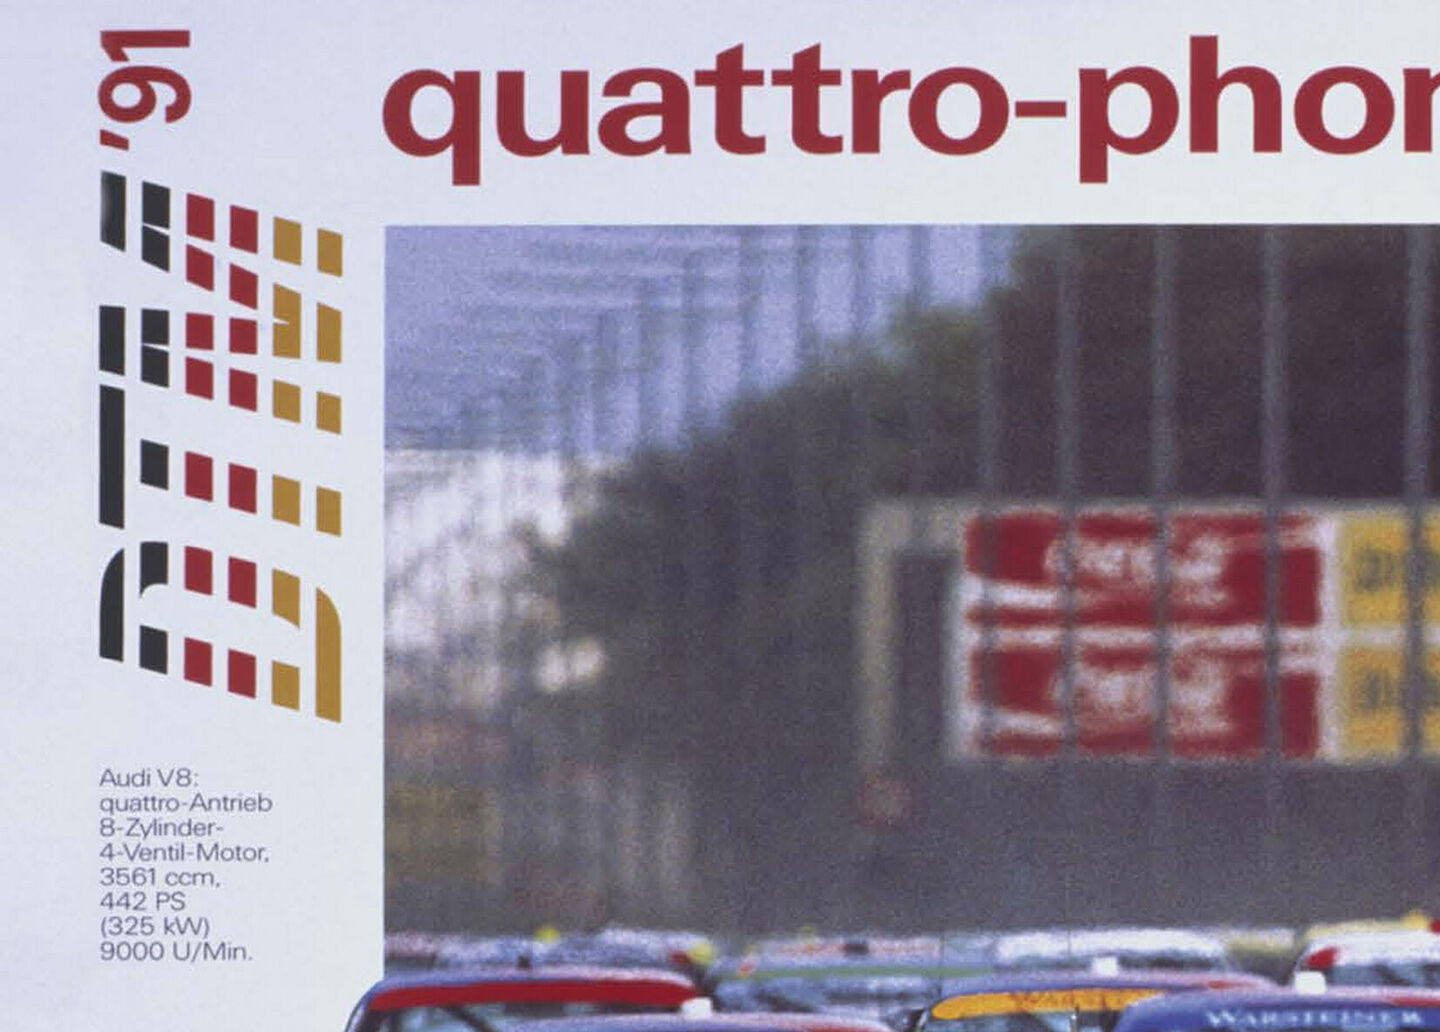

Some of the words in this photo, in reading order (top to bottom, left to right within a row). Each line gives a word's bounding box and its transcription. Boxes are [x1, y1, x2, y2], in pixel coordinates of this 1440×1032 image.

[99, 768, 151, 787] Audi
[157, 768, 198, 787] V8:
[100, 793, 273, 815] quattro-Antrieb
[100, 818, 223, 840] 8-Zylinder-
[100, 843, 268, 862] 4-Ventil-Motor,
[101, 866, 158, 888] 3561
[165, 872, 220, 887] ccm,
[100, 891, 146, 911] 442
[156, 891, 185, 911] PS
[101, 914, 155, 938] (325
[164, 916, 209, 939] kW)
[99, 940, 165, 962] 9000
[173, 942, 252, 963] U/Min.
